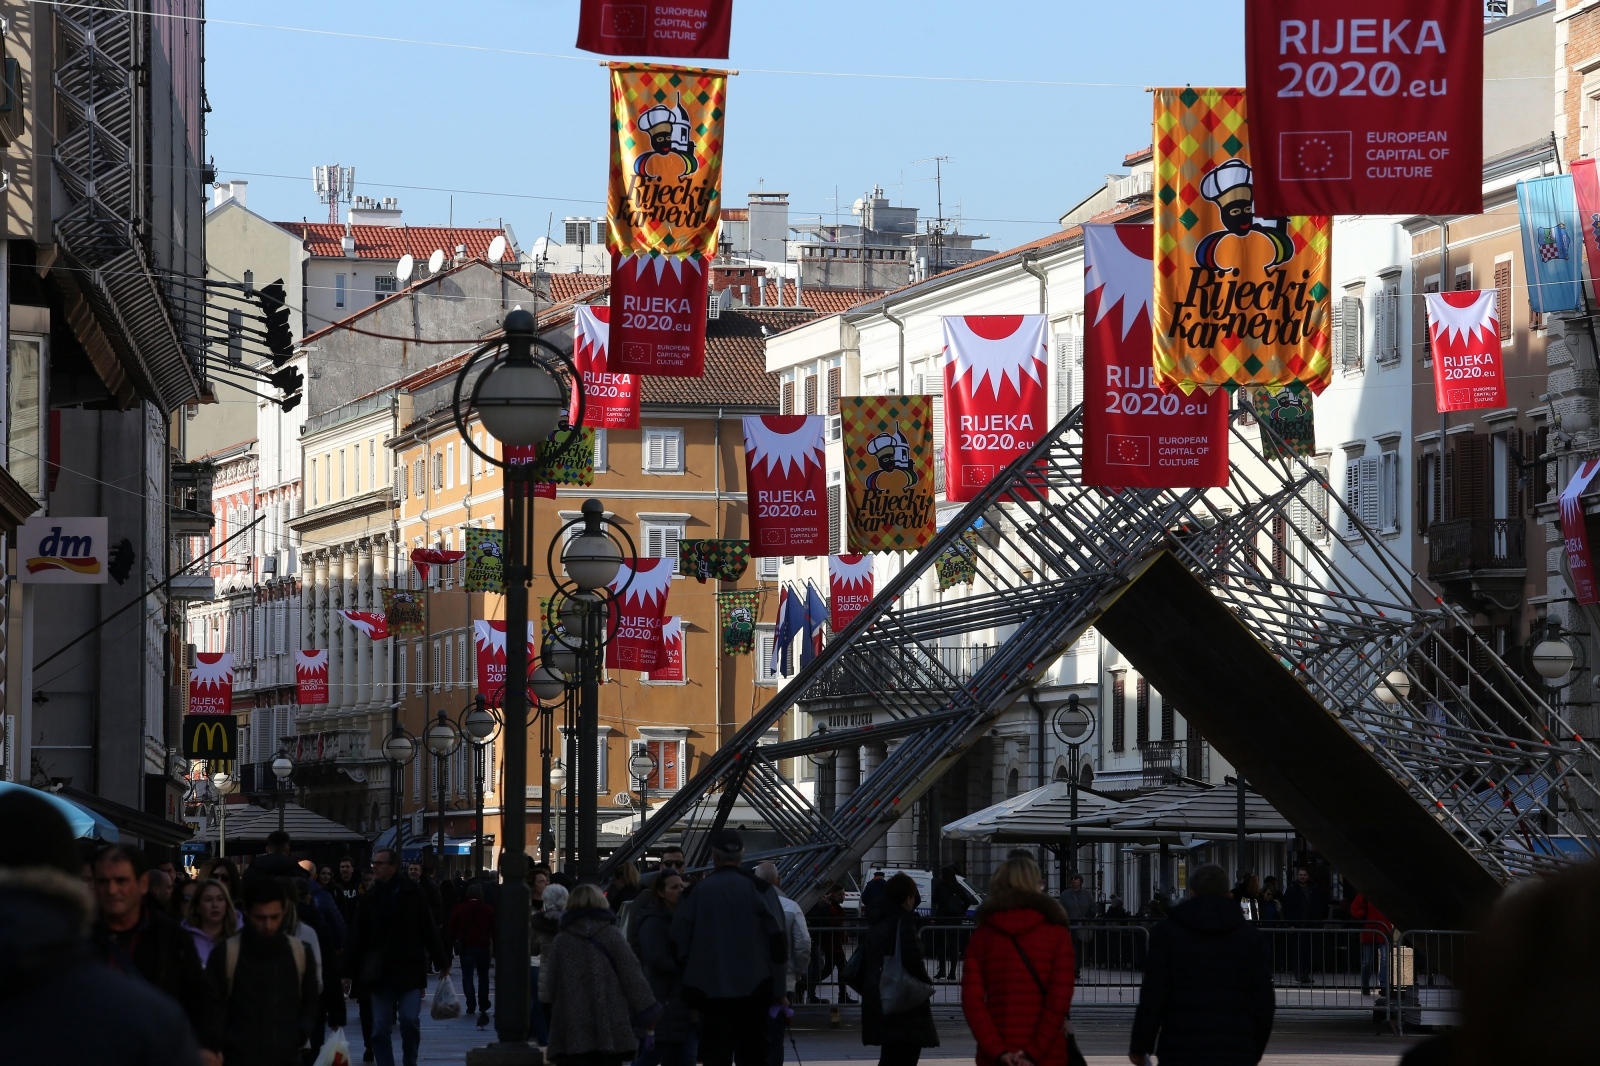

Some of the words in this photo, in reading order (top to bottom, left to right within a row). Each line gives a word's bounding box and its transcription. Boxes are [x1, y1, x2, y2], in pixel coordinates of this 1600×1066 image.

[655, 6, 707, 18] EUROPEAN
[654, 18, 692, 29] CAPITAL
[694, 21, 708, 30] OF
[653, 30, 697, 41] CULTURE
[1280, 18, 1446, 55] RIJEKA
[1277, 61, 1447, 98] 2020.eu
[1366, 131, 1448, 143] EUROPEAN
[1366, 149, 1426, 161] CAPITAL
[1428, 148, 1449, 160] OF
[1366, 166, 1433, 179] CULTURE
[616, 196, 711, 228] karneval
[623, 294, 692, 314] RIJEKA
[621, 312, 691, 332] 2020.eu
[1168, 299, 1315, 349] karneval
[656, 351, 681, 359] CAPITAL
[657, 344, 691, 352] EUROPEAN
[1443, 353, 1494, 368] RIJEKA
[583, 370, 632, 385] RIJEKA
[1444, 366, 1496, 380] 2020.eu
[583, 383, 632, 398] 2020.eu
[1105, 390, 1208, 416] 2020.eu
[960, 414, 1034, 432] RIJEKA
[960, 433, 1034, 451] 2020.eu
[1158, 436, 1208, 445] EUROPEAN
[1158, 447, 1195, 455] CAPITAL
[1196, 447, 1210, 455] OF
[1158, 458, 1200, 467] CULTURE
[758, 489, 816, 503] RIJEKA
[758, 504, 817, 518] 2020.eu
[853, 504, 930, 532] karneval
[38, 526, 92, 557] dm
[837, 594, 870, 603] RIJEKA
[190, 697, 225, 705] RIJEKA
[190, 705, 225, 714] 2020.eu
